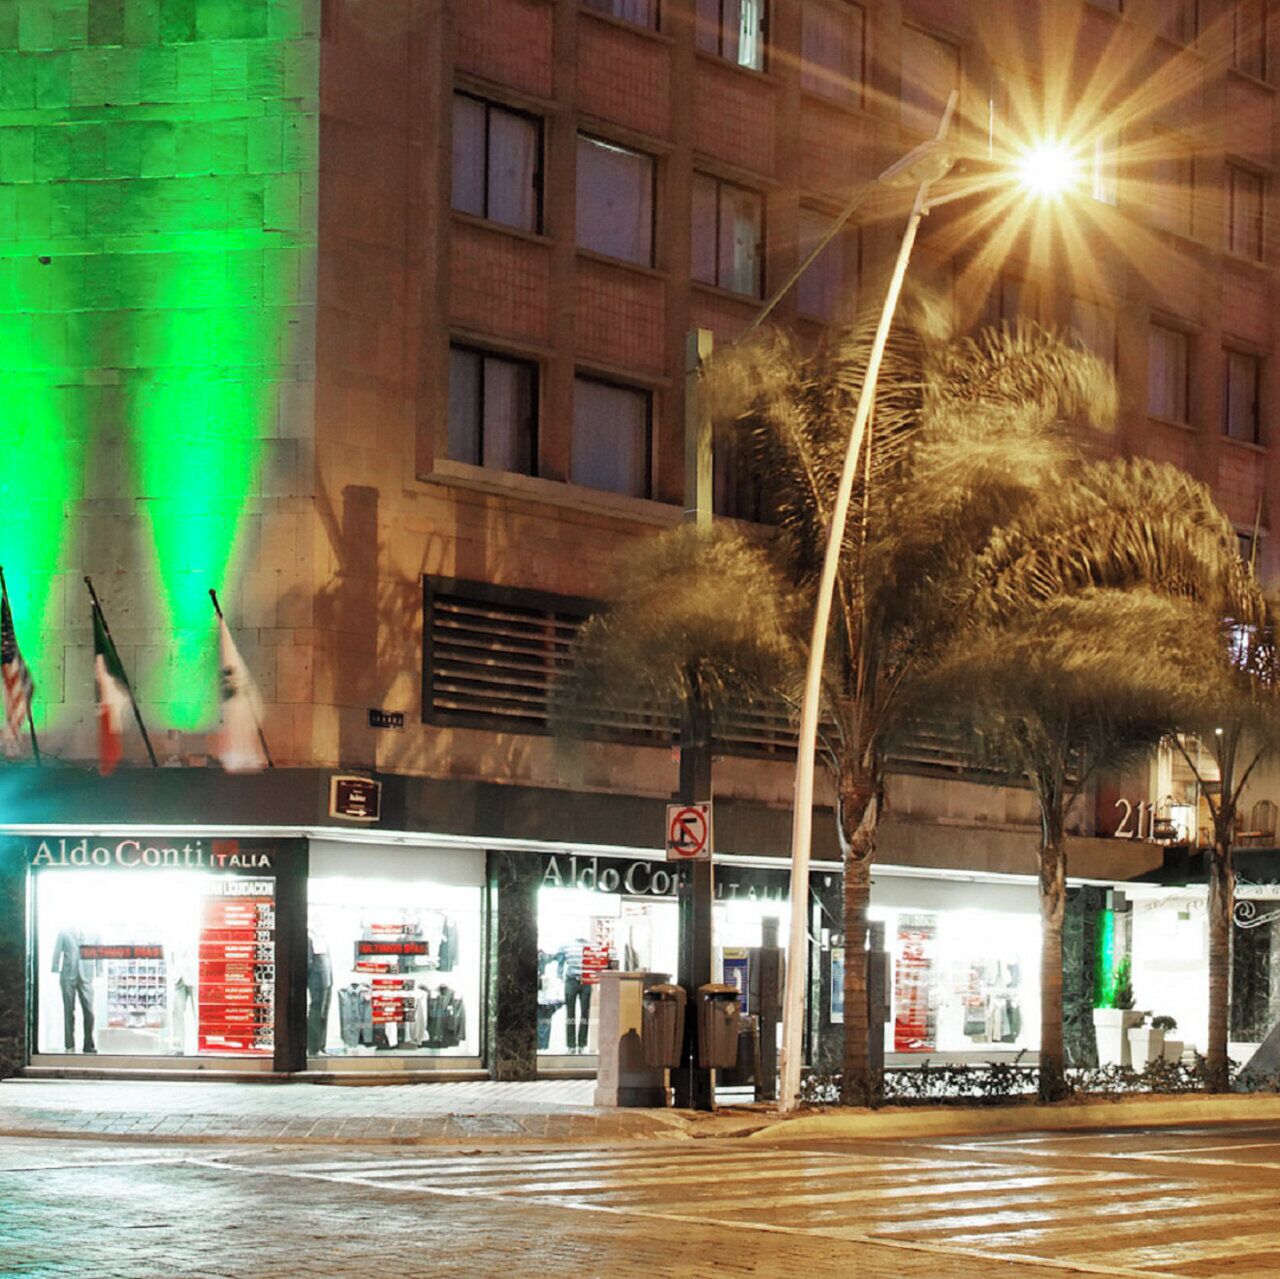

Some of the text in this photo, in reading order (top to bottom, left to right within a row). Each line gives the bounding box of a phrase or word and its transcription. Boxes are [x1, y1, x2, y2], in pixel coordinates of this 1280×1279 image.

[1115, 799, 1155, 840] 211
[32, 839, 271, 868] Aldo Conti ITALIA
[542, 855, 620, 893] Aldo
